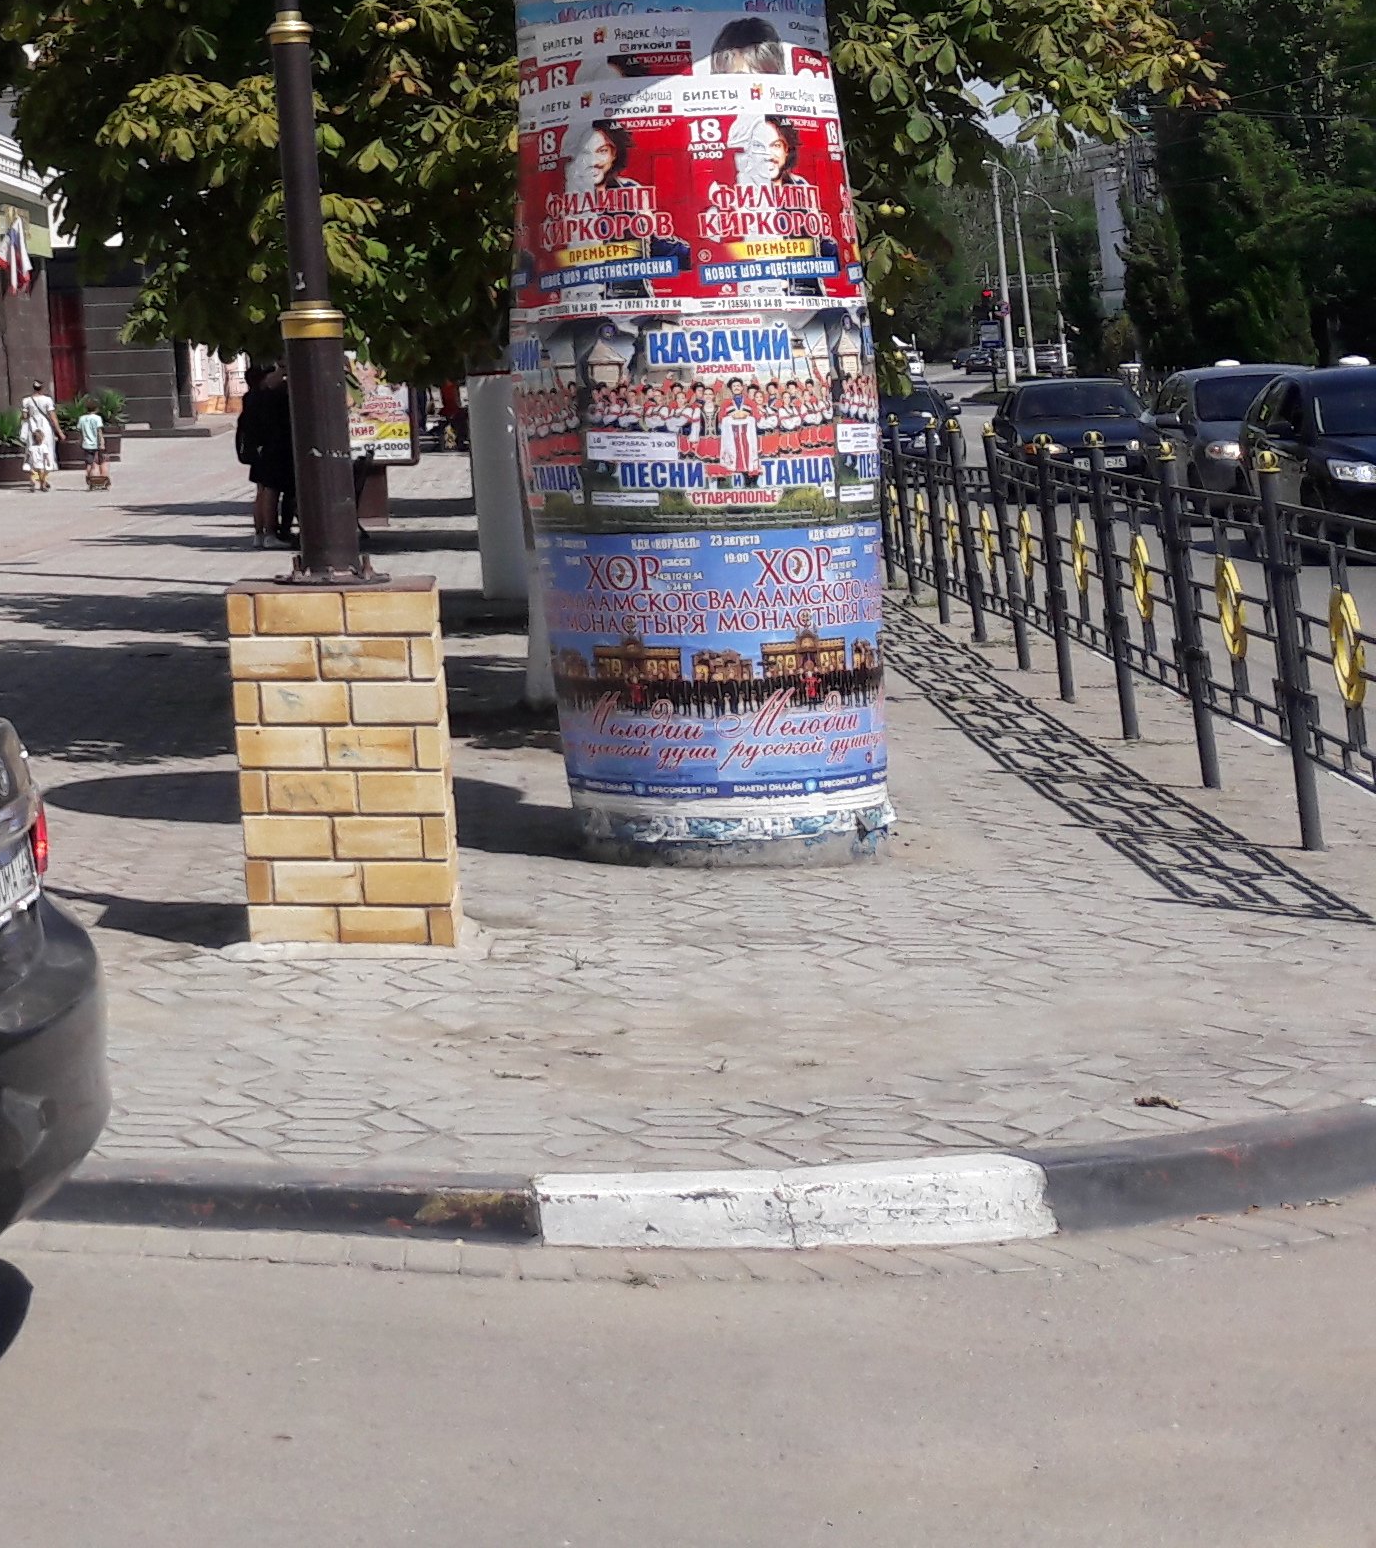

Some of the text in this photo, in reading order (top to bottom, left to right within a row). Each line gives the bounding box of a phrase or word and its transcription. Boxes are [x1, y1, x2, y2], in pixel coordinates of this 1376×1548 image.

[682, 89, 739, 101] БИЛЕТЫ
[688, 118, 722, 142] 18
[693, 151, 723, 160] 19:00
[547, 186, 657, 221] ФИЛИПП
[711, 183, 822, 211] ФИЛИПП
[540, 212, 675, 252] КИРКОРОВ
[698, 211, 832, 239] КИРКОРОВ
[568, 244, 629, 263] ПРЕМЬЕРА
[746, 243, 807, 256] ПРЕМЬЕРА
[704, 266, 737, 282] НОВОЕ
[740, 263, 763, 278] ШОУ
[648, 321, 792, 365] КАЗАЧИЙ
[620, 461, 704, 488] ПЕСНИ
[761, 456, 835, 487] ТАНЦА
[724, 552, 750, 564] 19:00
[753, 546, 832, 586] ХОР
[584, 555, 661, 591] ХОР
[709, 581, 861, 610] ВАЛААМСКОГО
[717, 603, 859, 632] МОНАСТЫРЯ
[715, 686, 860, 738] Мелодии
[718, 735, 825, 771] русской
